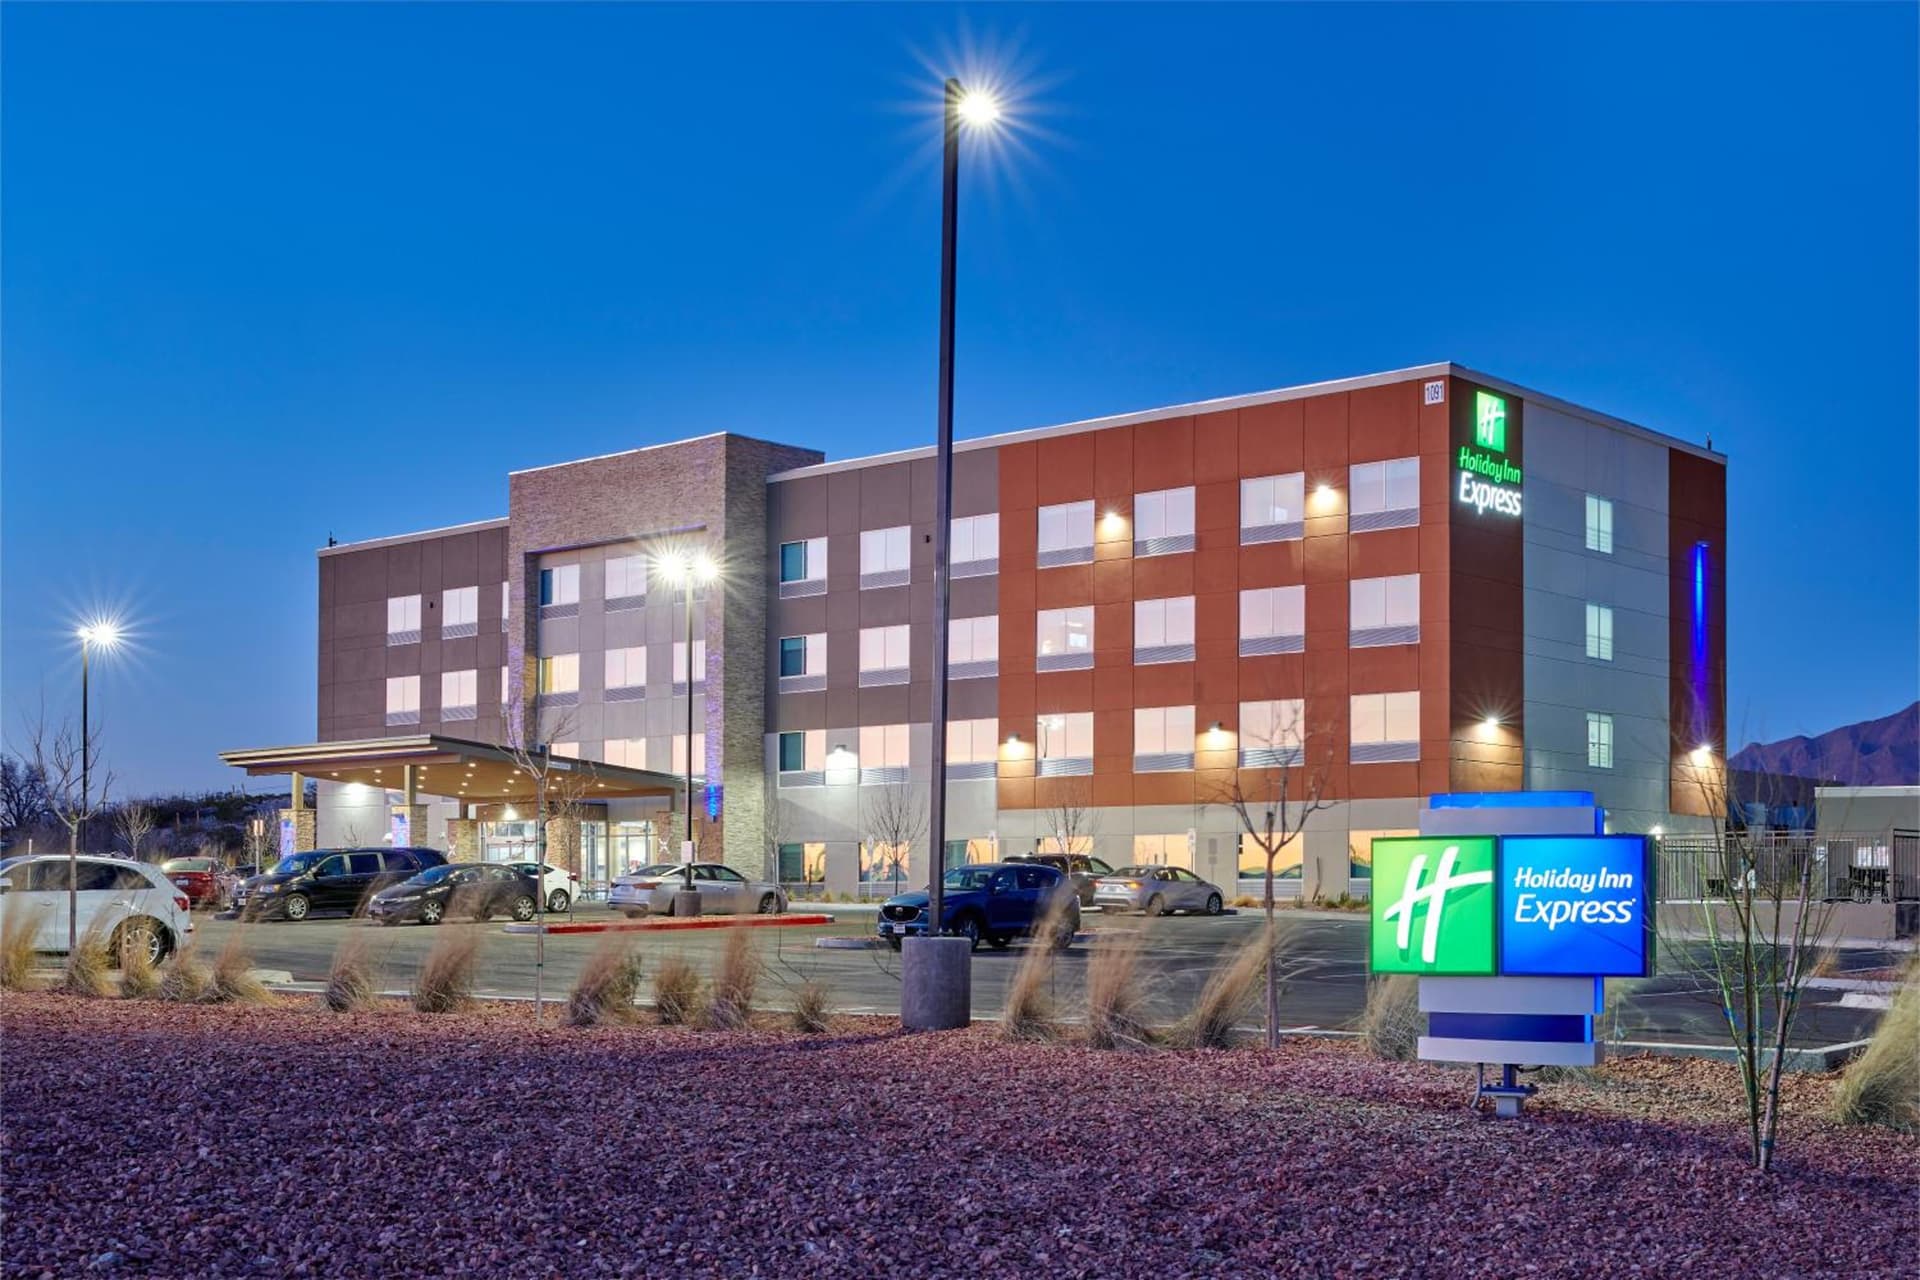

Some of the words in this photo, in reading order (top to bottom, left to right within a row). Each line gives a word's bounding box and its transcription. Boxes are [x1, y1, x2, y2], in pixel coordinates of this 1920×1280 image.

[1427, 383, 1443, 400] 1091
[1460, 446, 1501, 483] Holiday
[1503, 459, 1521, 484] Inn
[1459, 471, 1522, 517] Express
[1514, 866, 1597, 894] Holiday
[1598, 866, 1633, 889] Inn
[1384, 846, 1493, 964] H
[1514, 893, 1634, 931] Express
